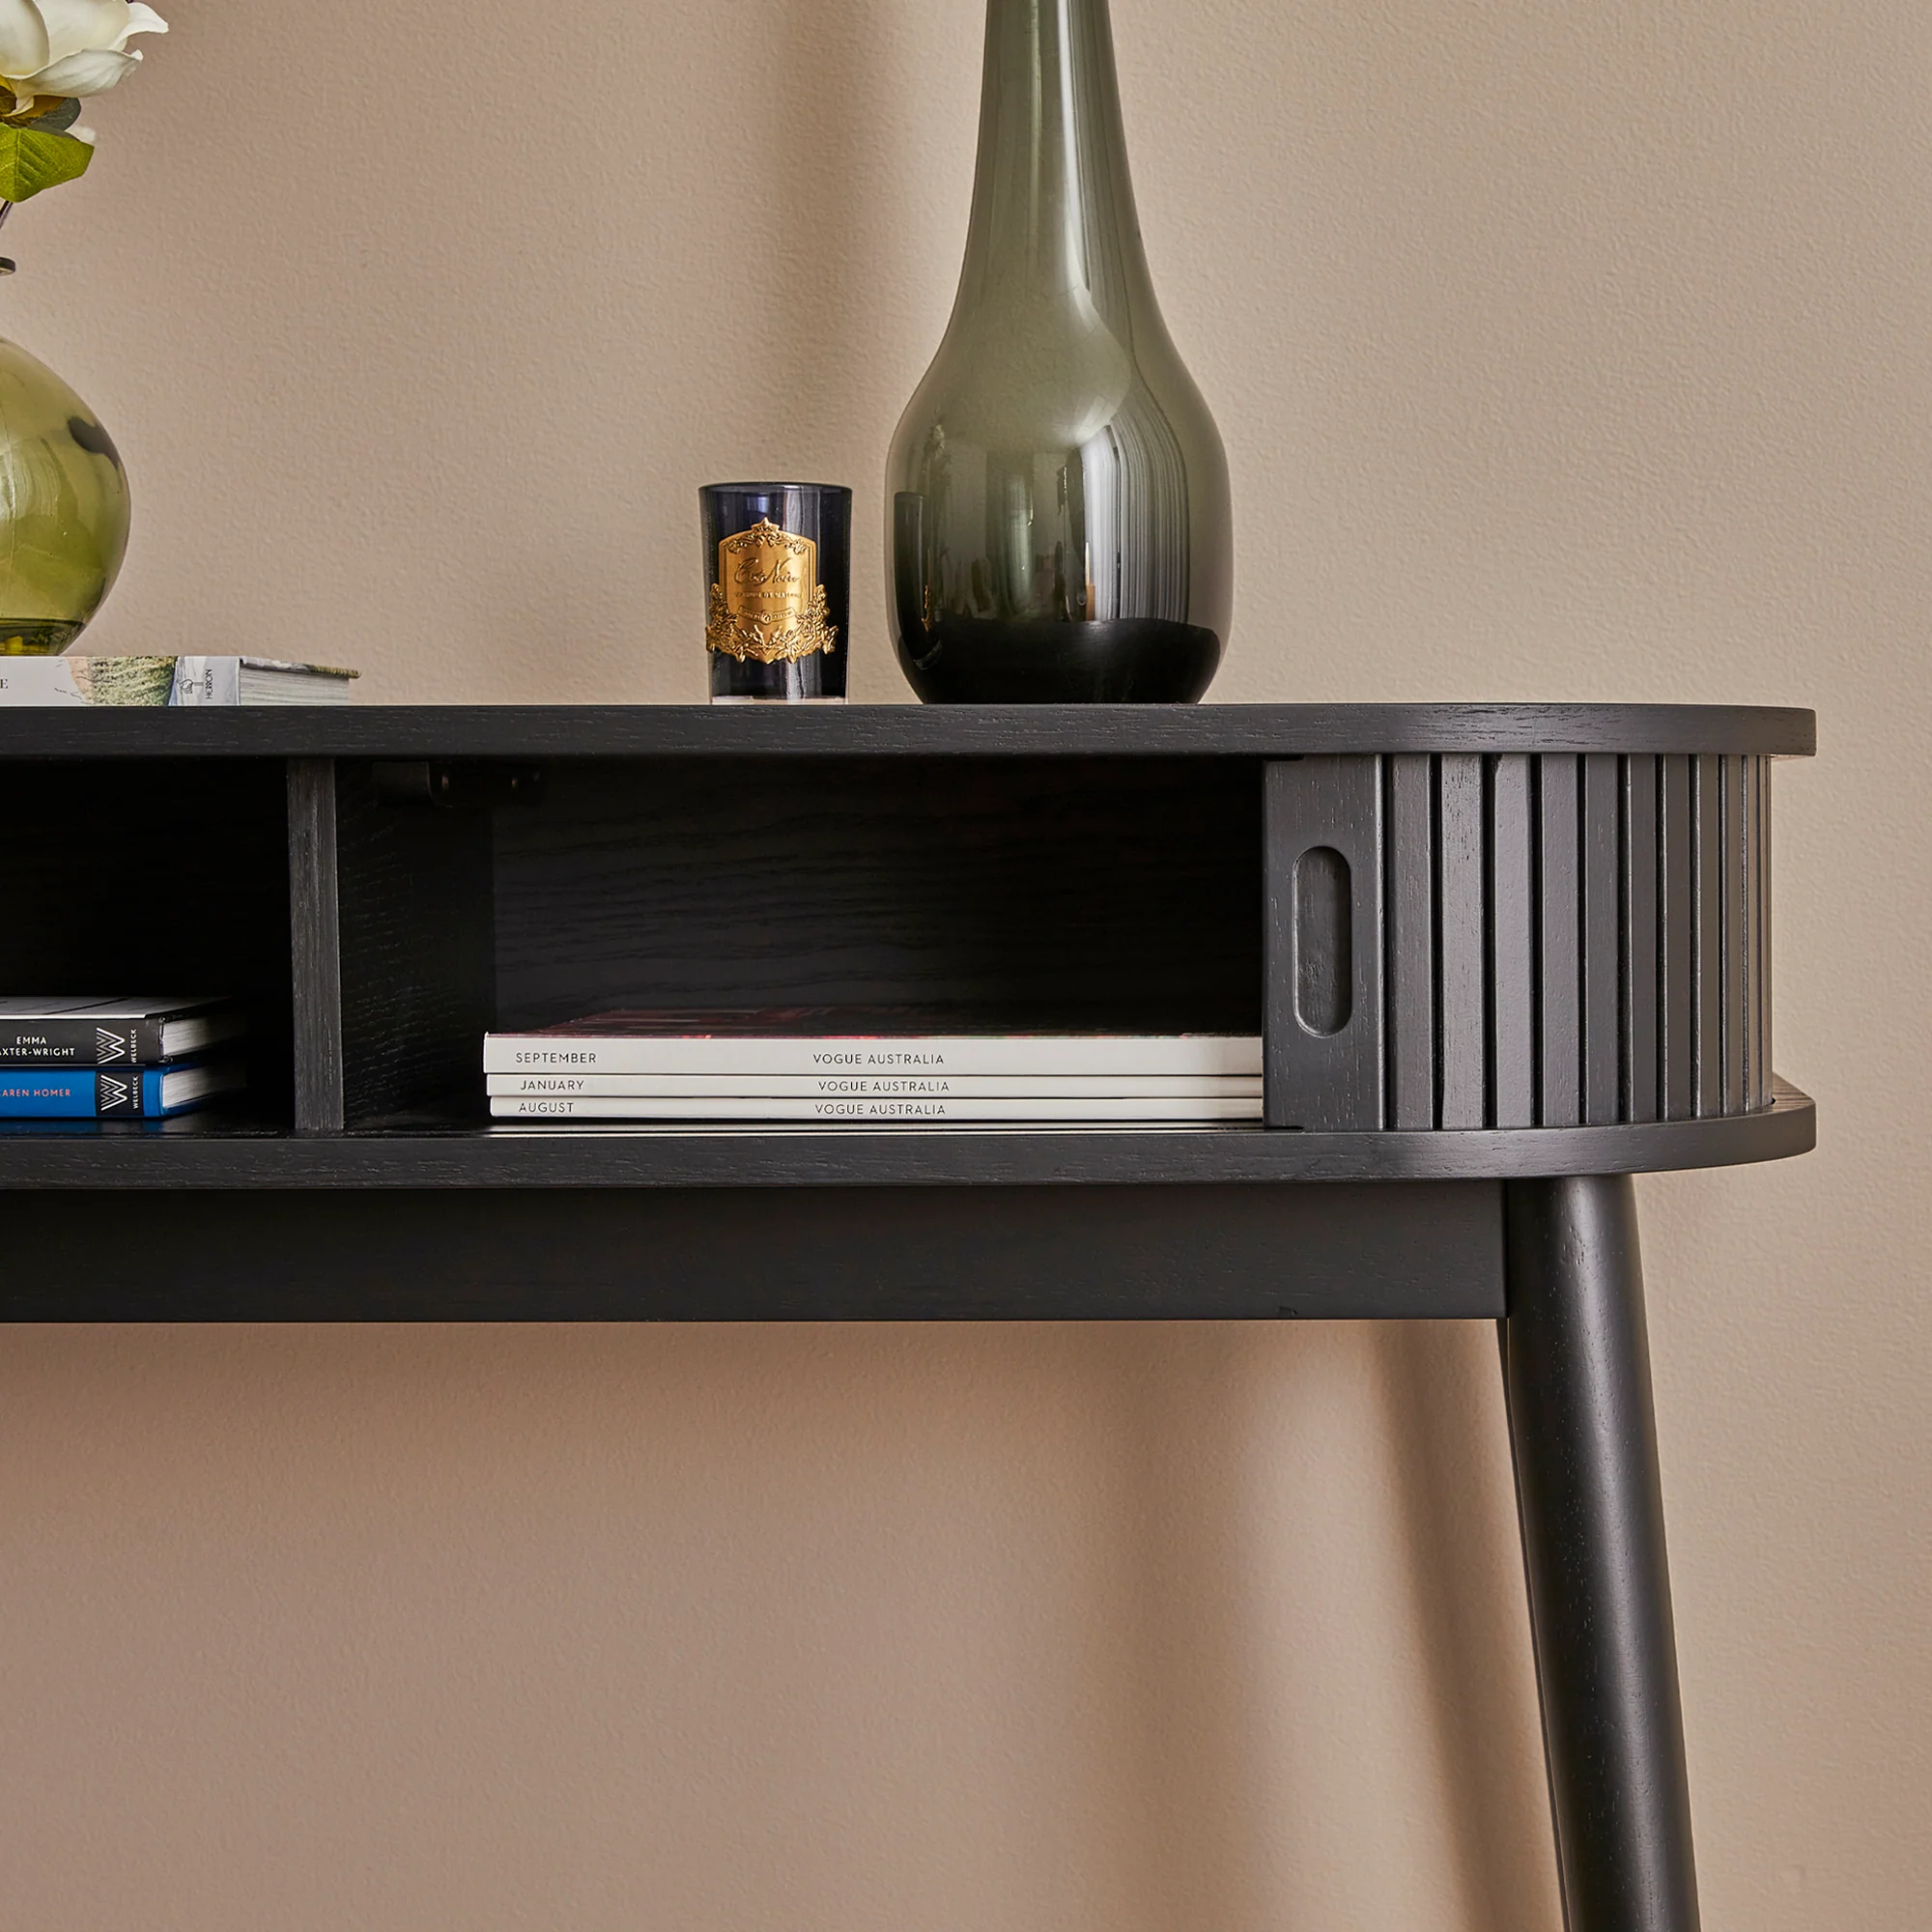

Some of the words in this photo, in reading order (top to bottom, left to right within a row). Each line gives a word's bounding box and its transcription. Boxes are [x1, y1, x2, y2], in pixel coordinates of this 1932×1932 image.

[16, 1036, 47, 1045] EMMA
[0, 1047, 75, 1057] XTER-WRIGHT
[516, 1052, 597, 1064] SEPTEMBER
[813, 1053, 863, 1065] VOGUE
[867, 1053, 944, 1065] AUSTRALIA
[521, 1080, 584, 1091] JANUARY
[818, 1080, 867, 1092] VOGUE
[872, 1080, 950, 1092] AUSTRALIA
[0, 1089, 30, 1097] AREN
[34, 1089, 71, 1097] HOMER
[519, 1102, 574, 1113] AUGUST
[815, 1103, 865, 1115] VOGUE
[869, 1103, 946, 1115] AUSTRALIA
